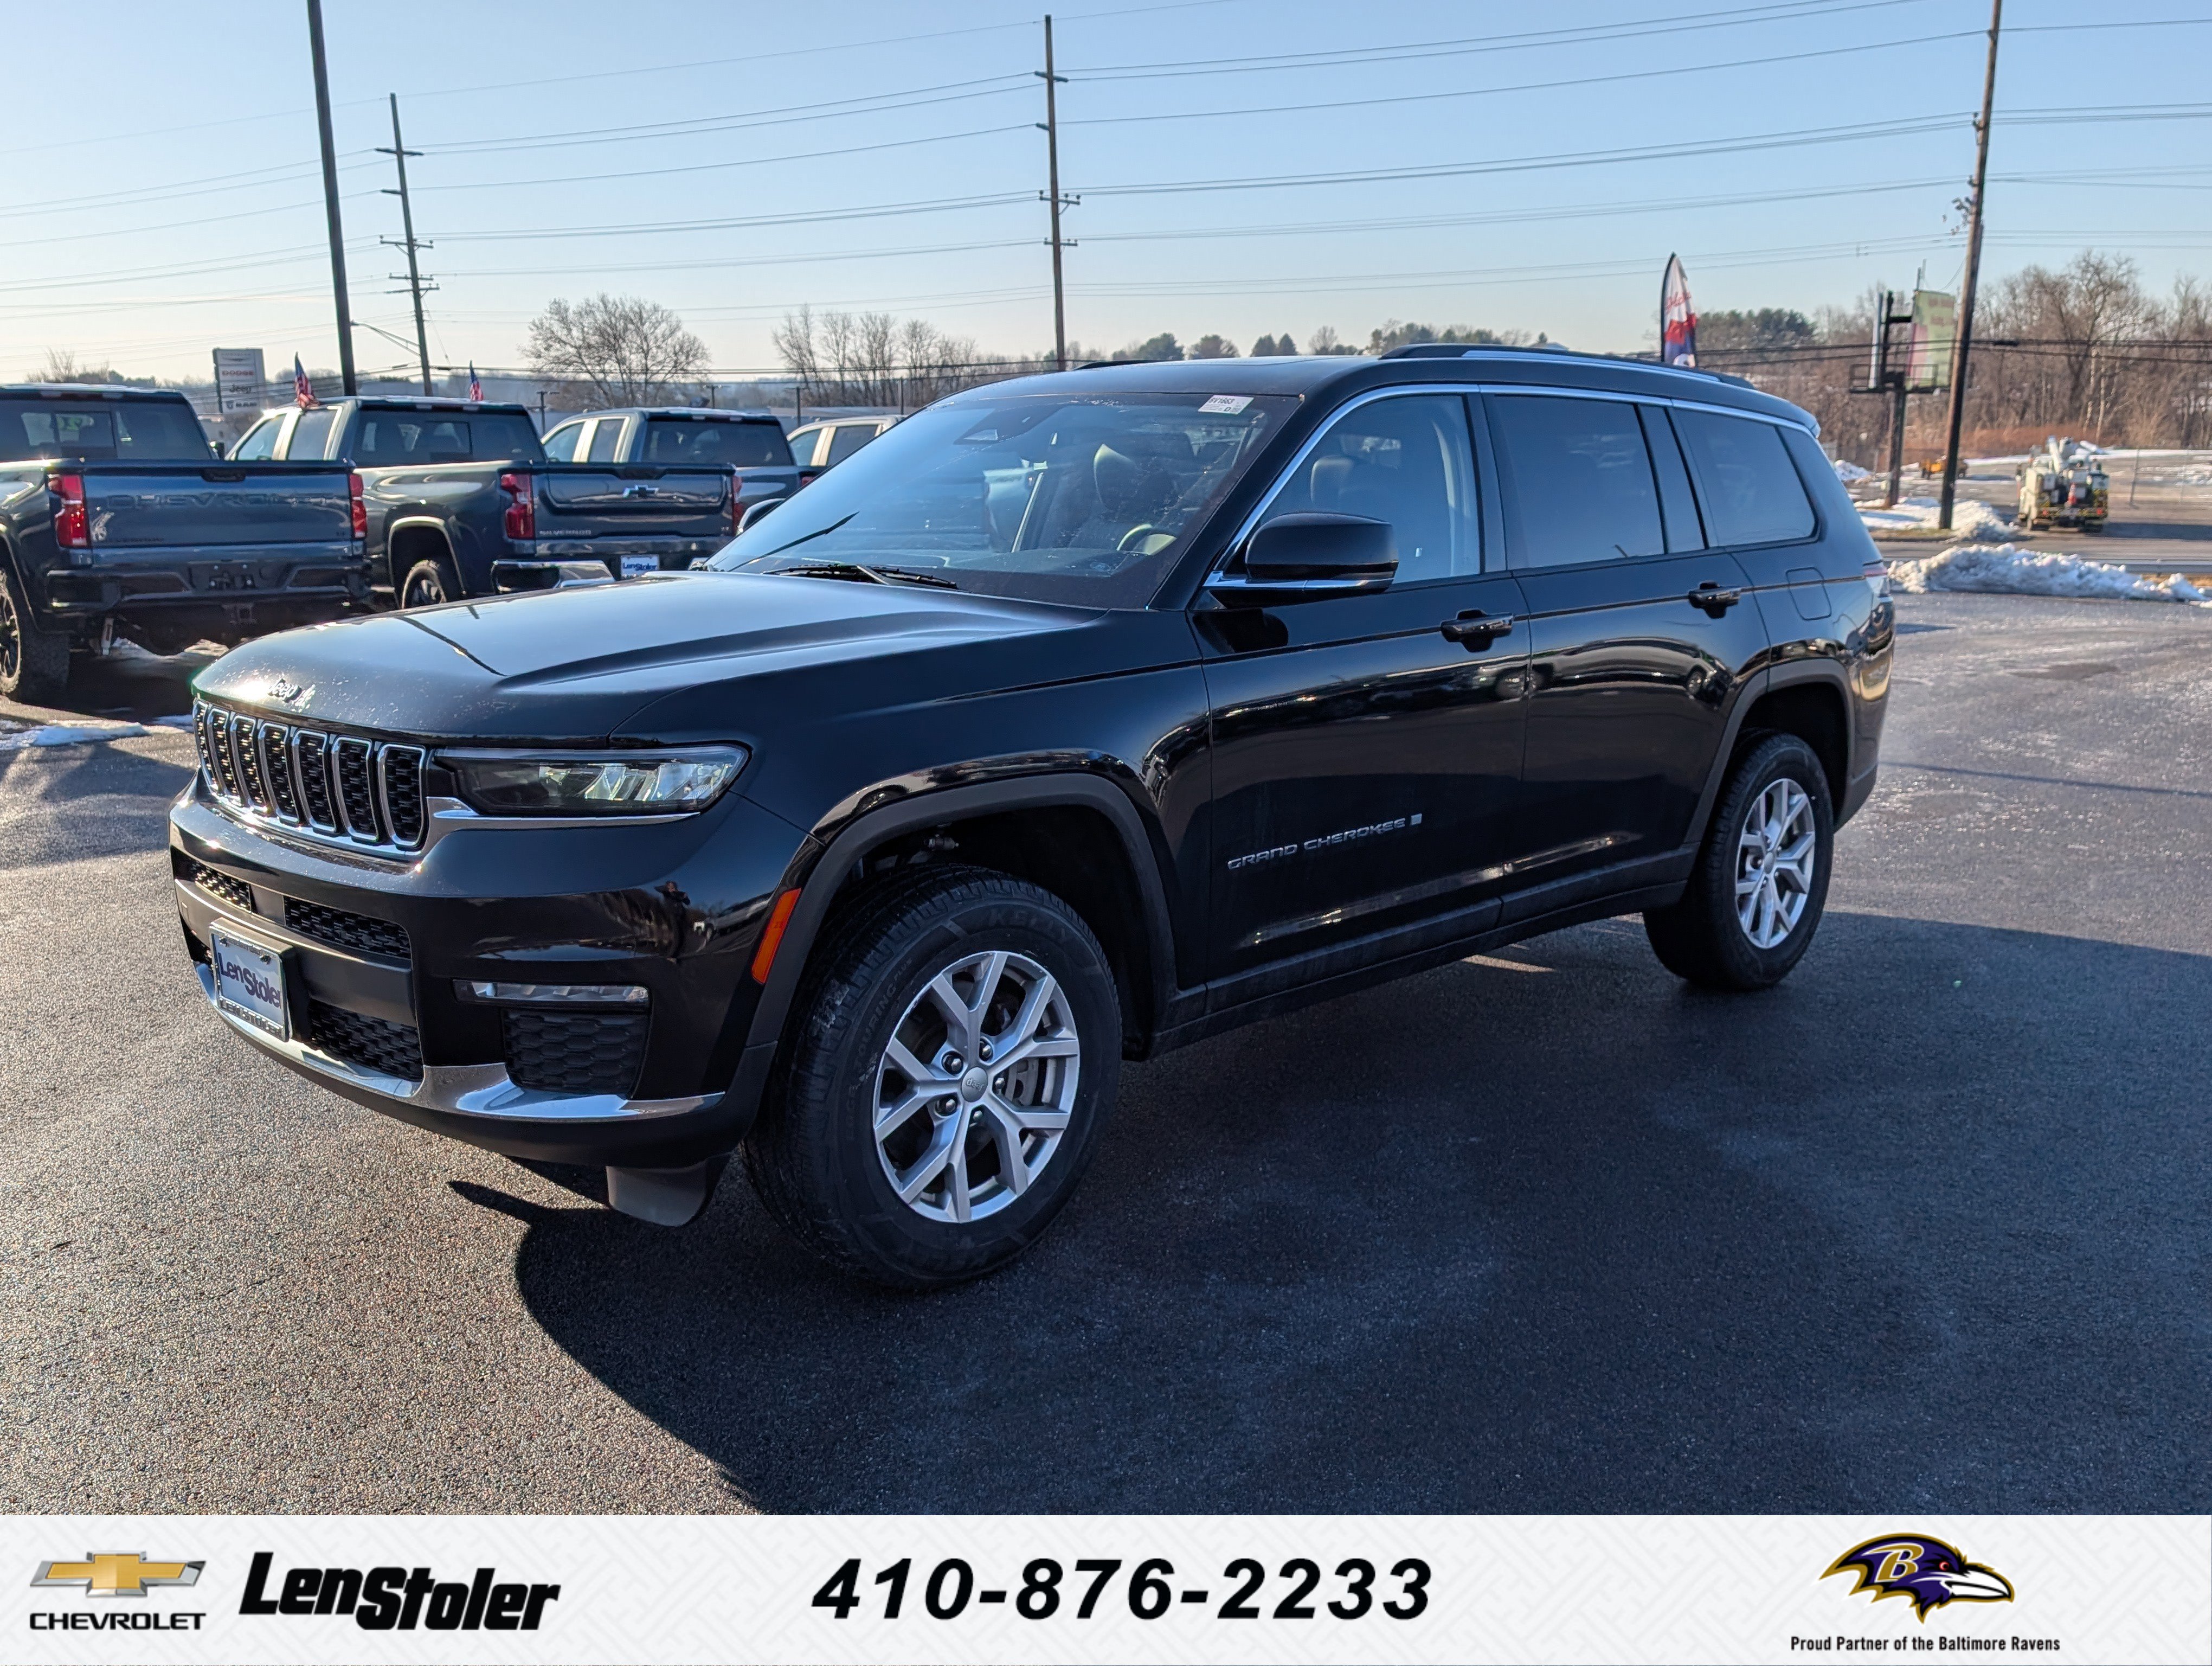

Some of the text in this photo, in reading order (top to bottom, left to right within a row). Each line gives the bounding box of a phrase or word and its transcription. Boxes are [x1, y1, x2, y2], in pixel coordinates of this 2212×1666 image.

[107, 492, 345, 508] CHEVRO
[1227, 818, 1406, 869] GRAND CHEROKEE
